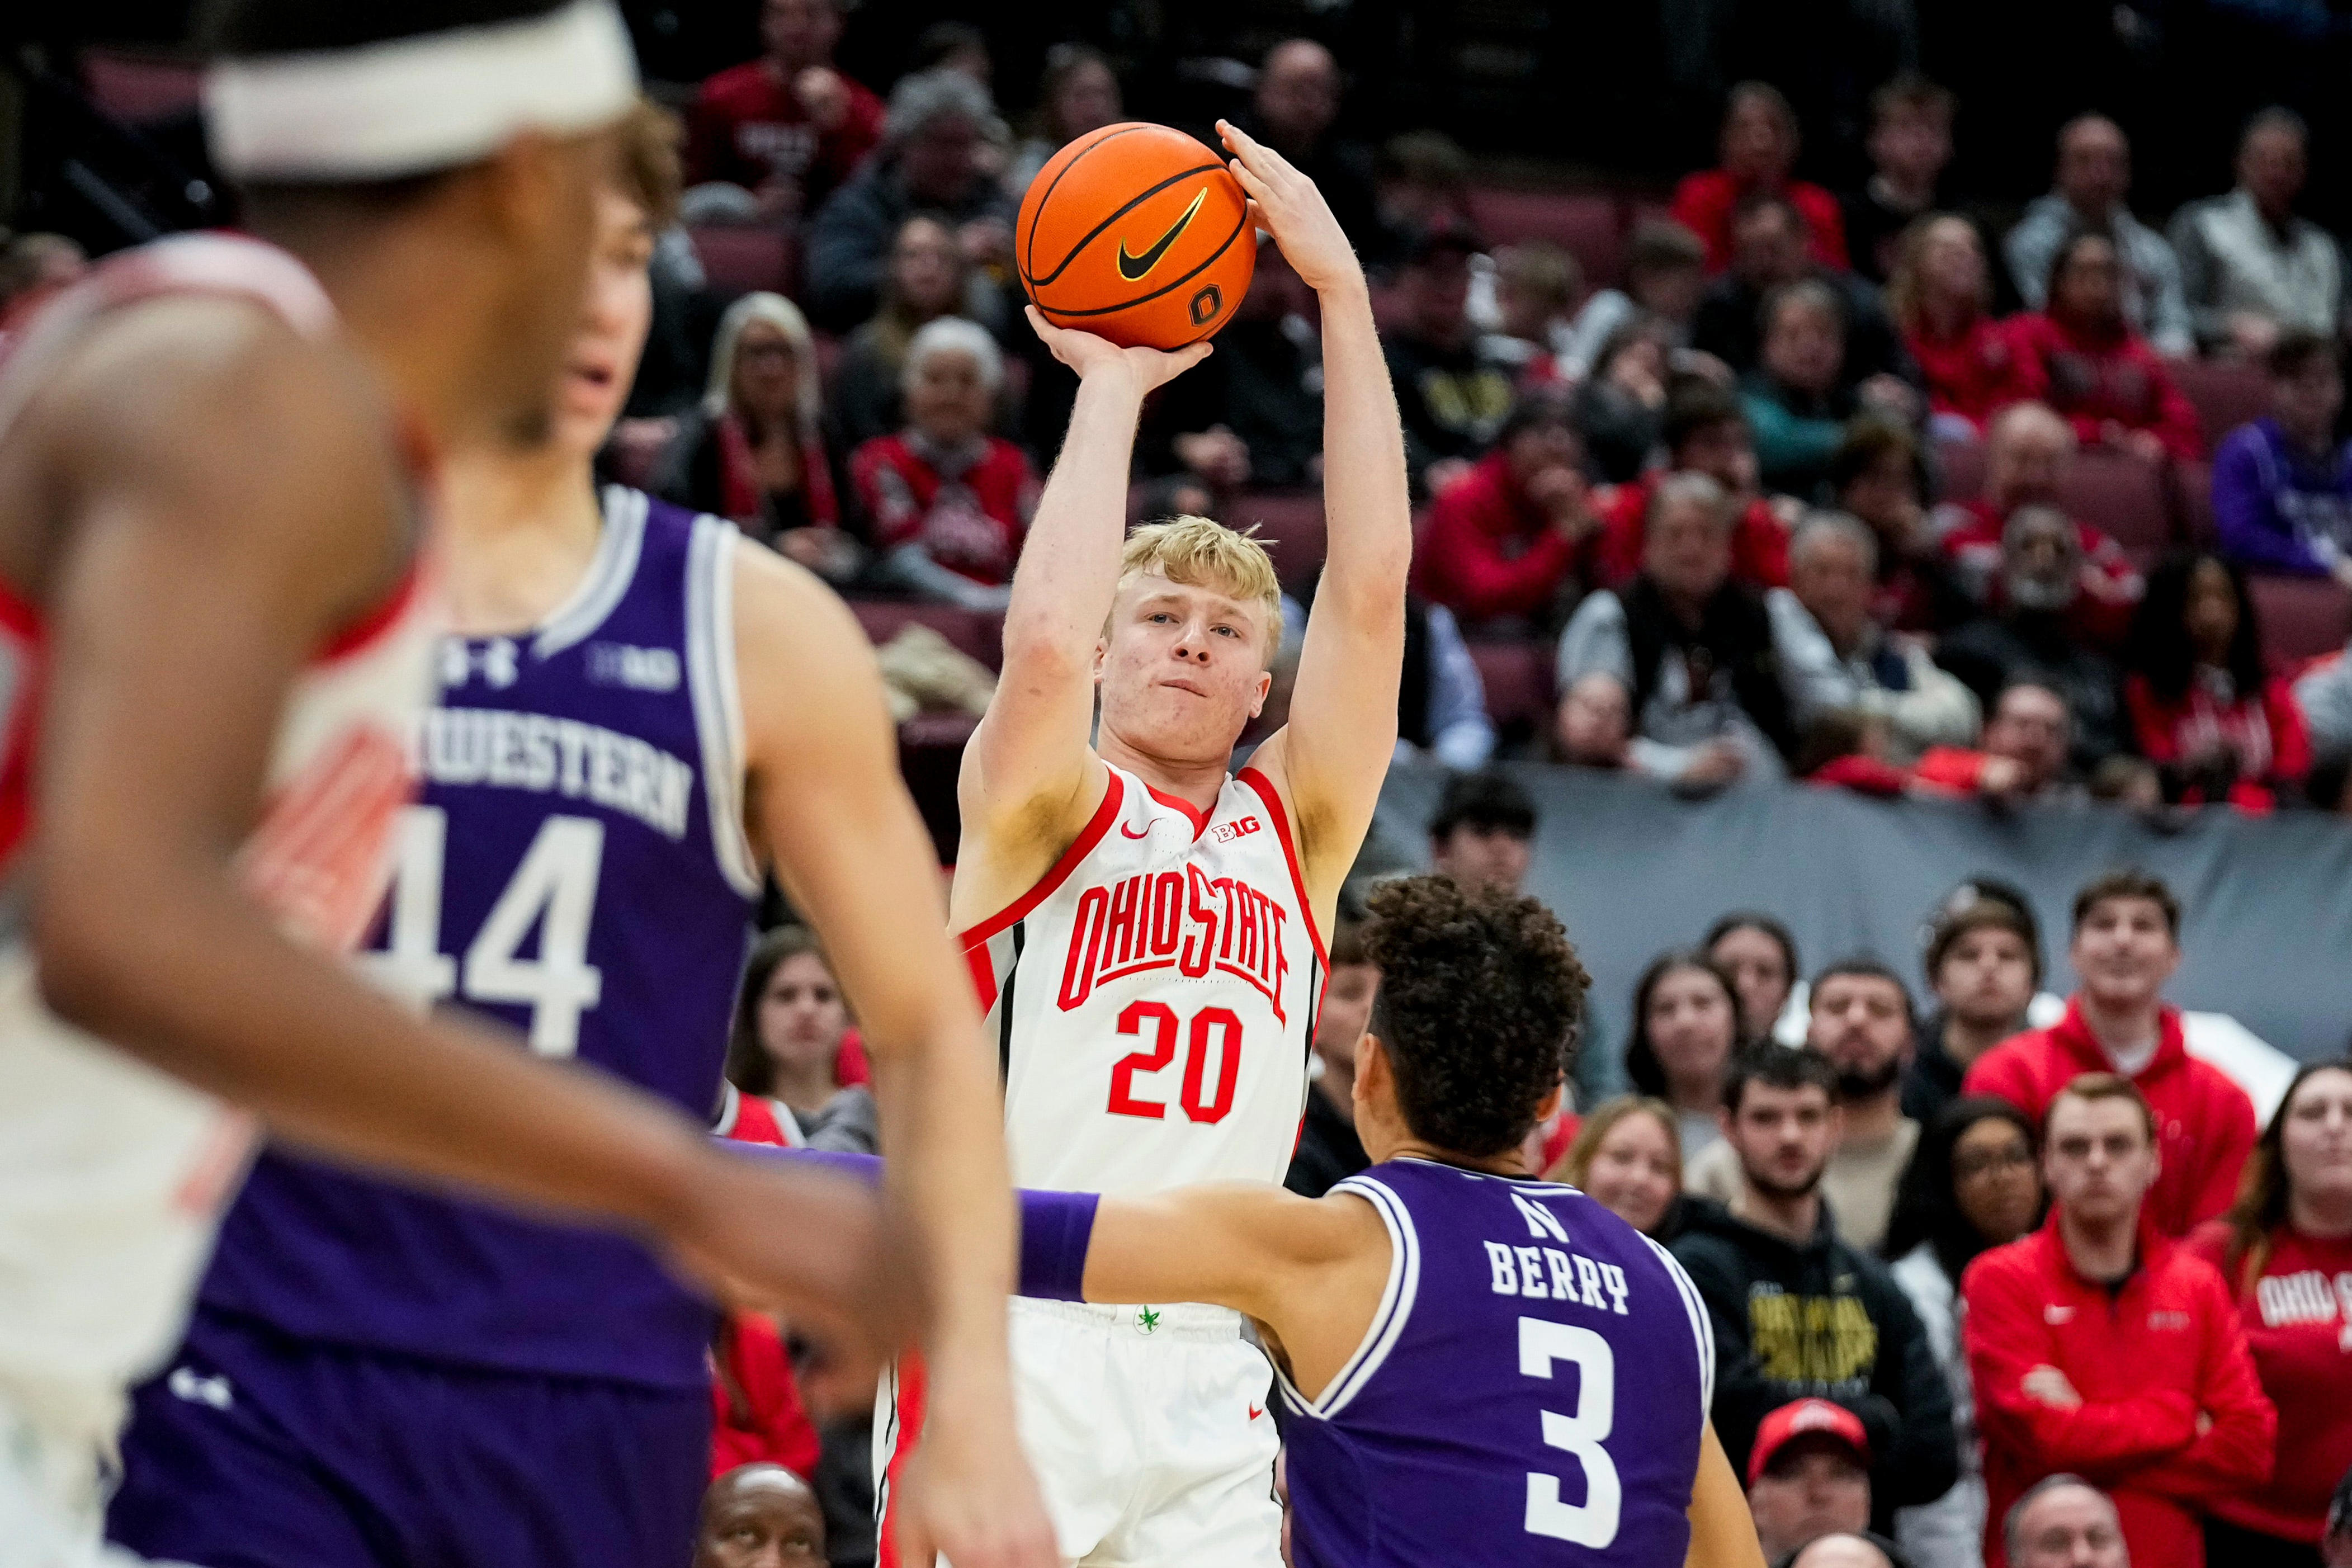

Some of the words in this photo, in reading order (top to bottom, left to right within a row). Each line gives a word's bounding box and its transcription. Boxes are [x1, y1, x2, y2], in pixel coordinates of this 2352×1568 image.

[1106, 999, 1244, 1126] 20
[1510, 1192, 1570, 1244] N
[1483, 1239, 1630, 1315] BERRY
[1518, 1315, 1622, 1550] 3
